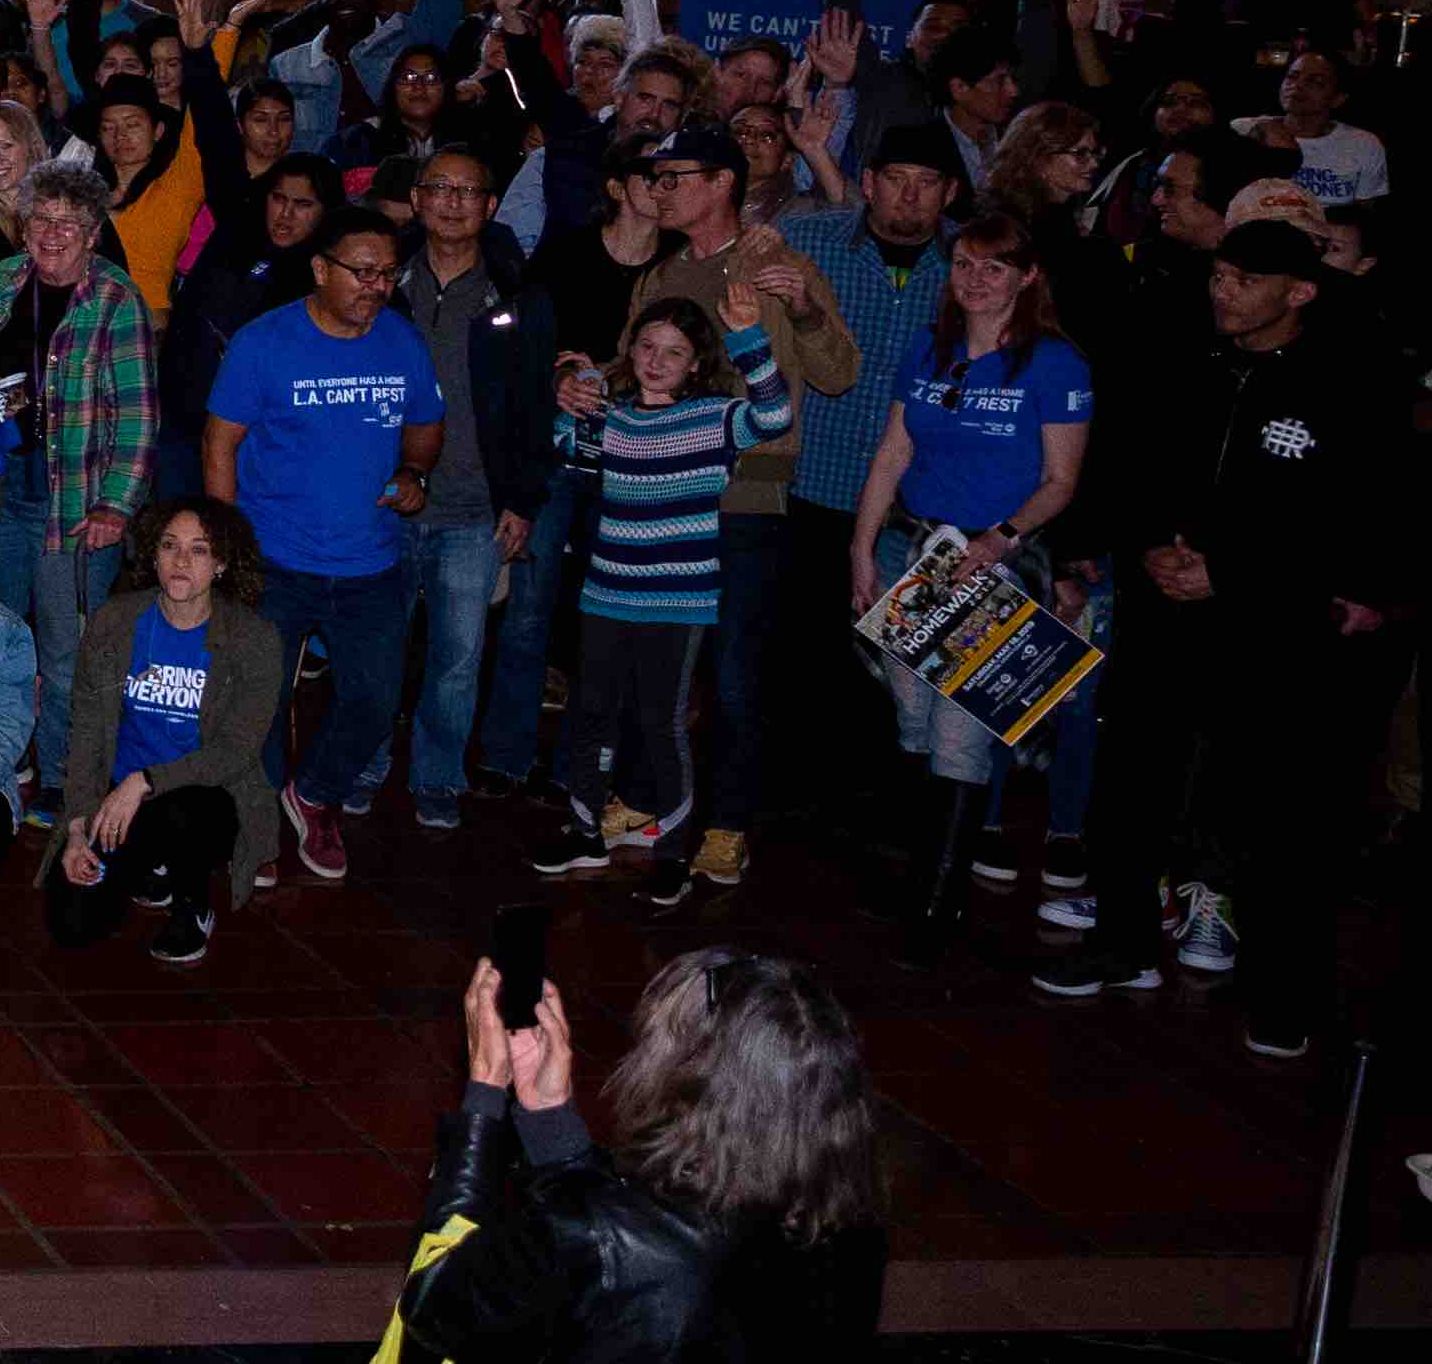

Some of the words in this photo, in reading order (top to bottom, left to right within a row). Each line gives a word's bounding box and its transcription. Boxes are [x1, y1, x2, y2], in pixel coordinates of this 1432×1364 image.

[707, 11, 742, 32] WE
[294, 379, 317, 389] UNTIL
[318, 377, 358, 388] EVERYONE
[359, 376, 376, 385] HAS
[377, 376, 384, 384] A
[385, 375, 405, 385] HOME
[294, 389, 323, 406] L.A.
[326, 387, 368, 404] CAN'T
[372, 387, 406, 404] REST
[976, 397, 1023, 413] REST
[899, 566, 991, 655] HOMEWALK
